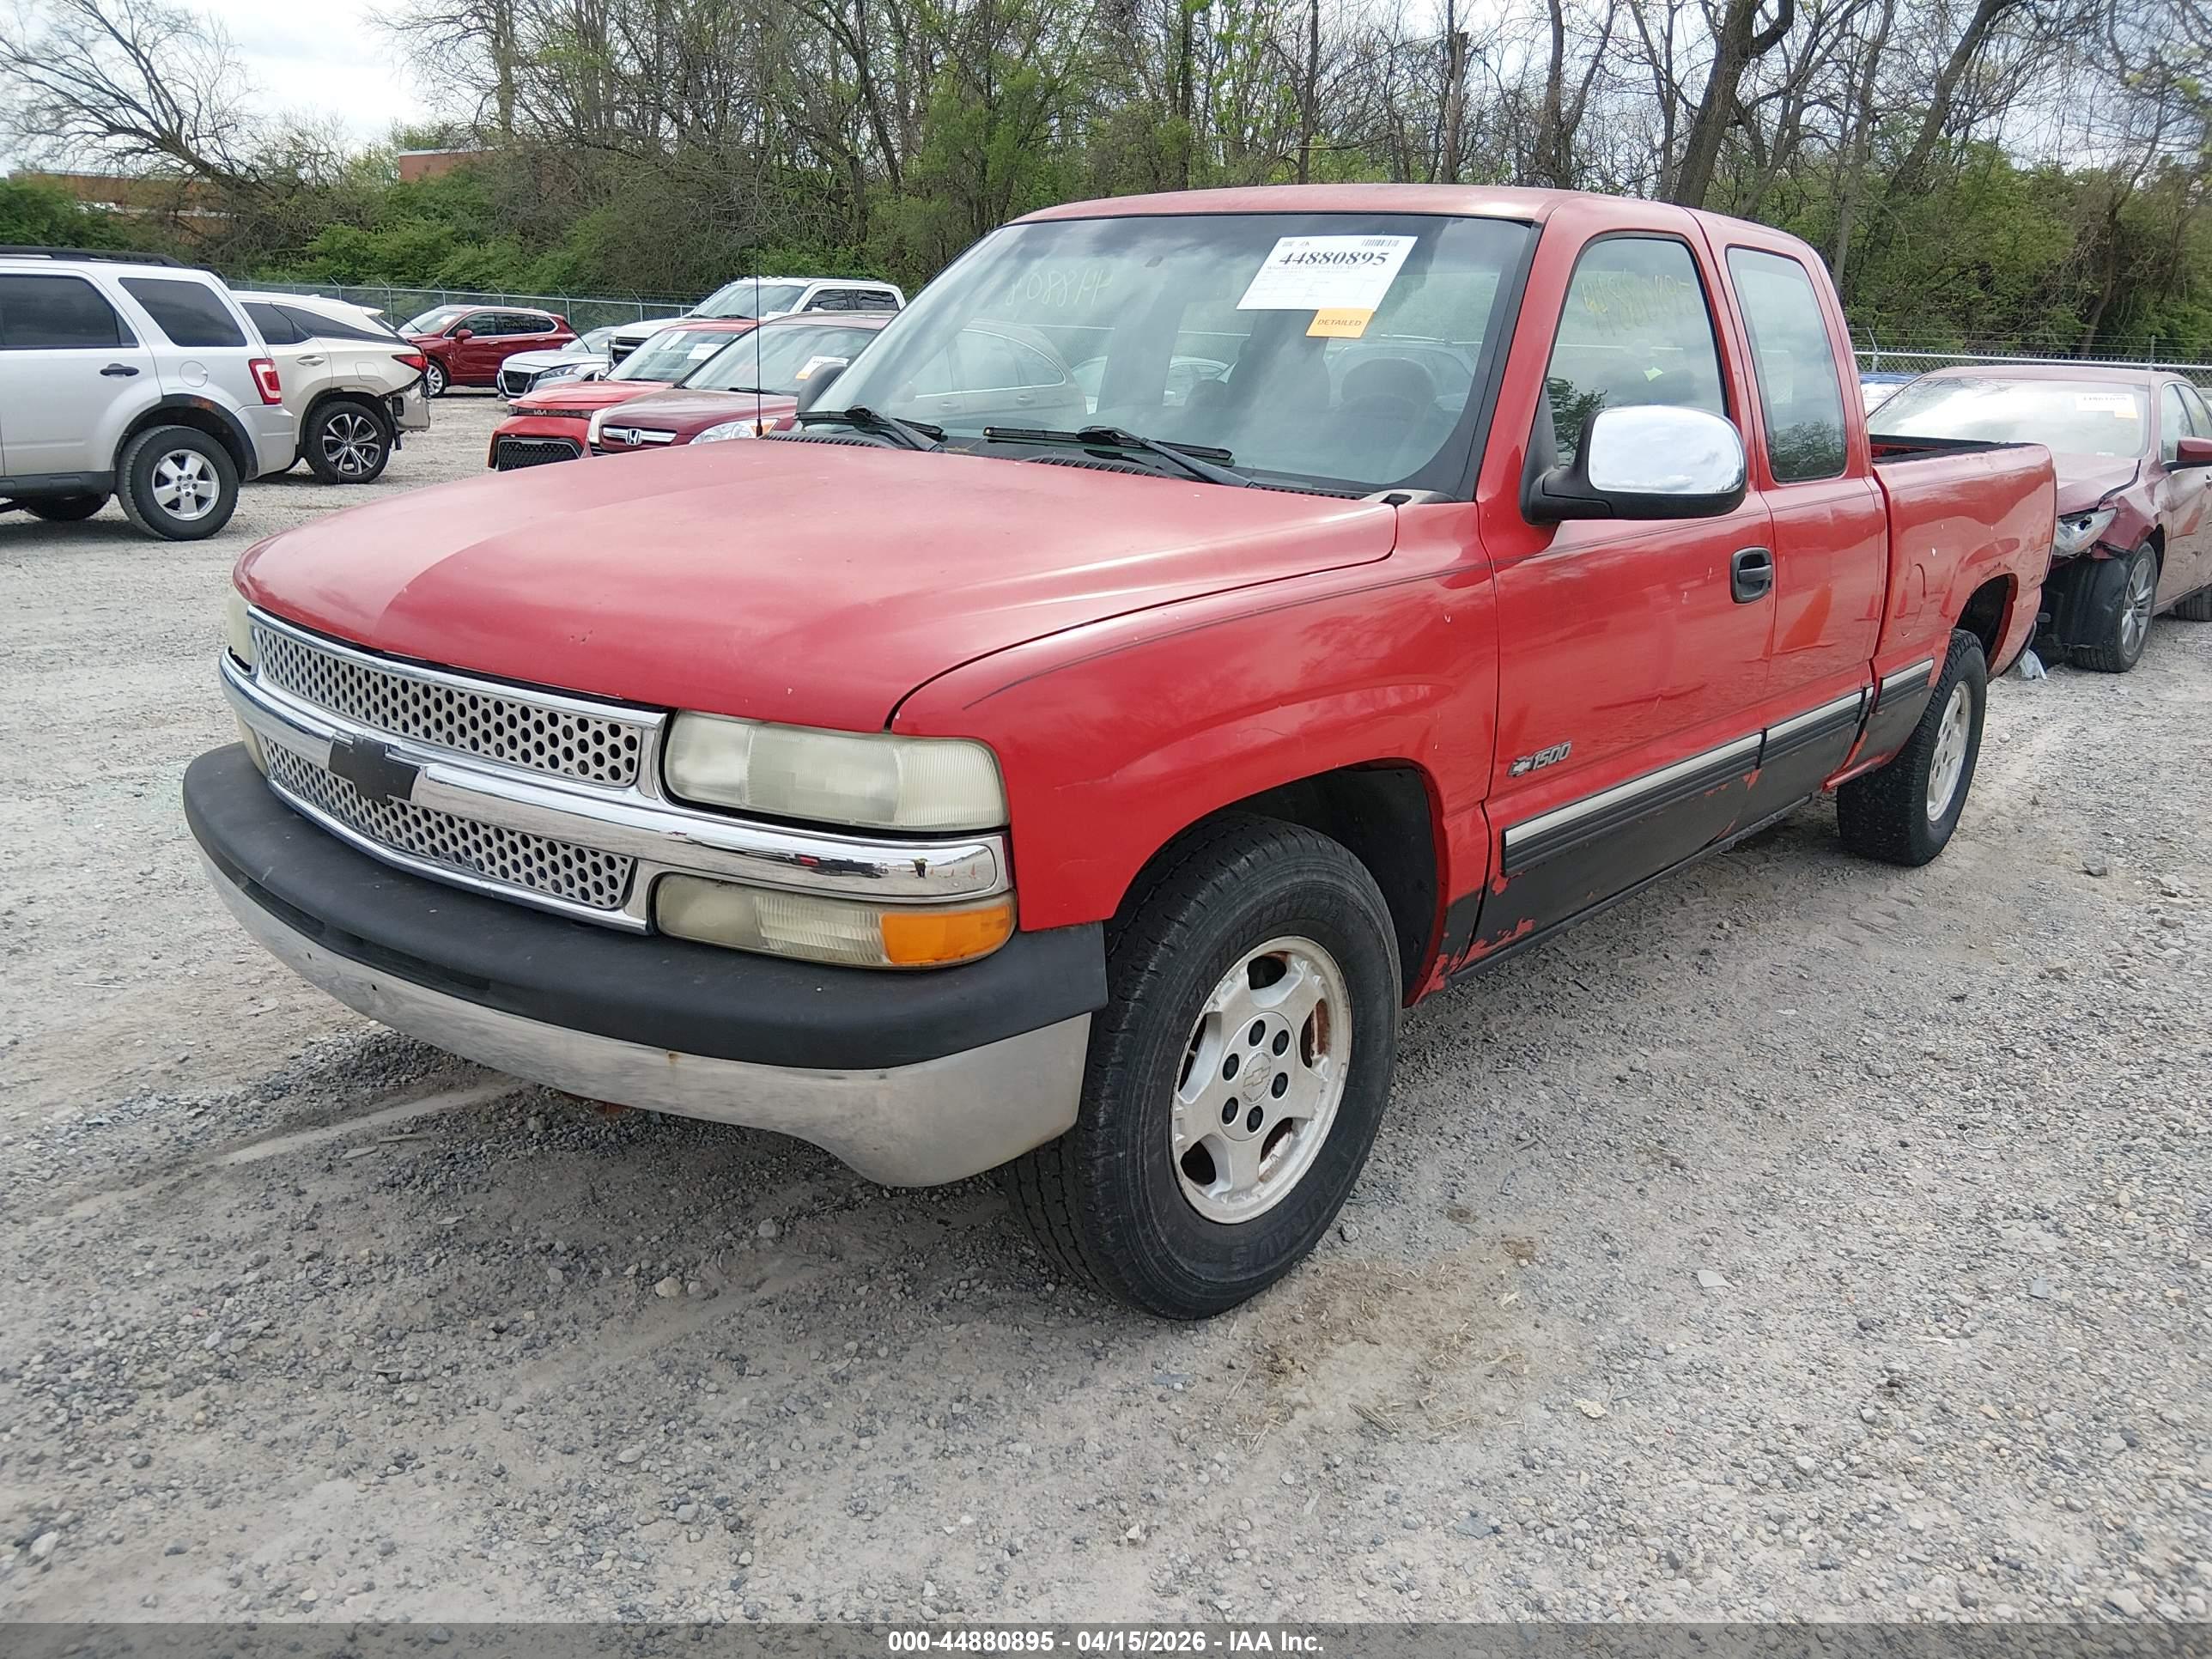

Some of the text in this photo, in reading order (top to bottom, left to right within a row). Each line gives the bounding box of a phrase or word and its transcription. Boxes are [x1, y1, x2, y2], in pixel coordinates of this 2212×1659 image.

[1279, 251, 1390, 266] 44880895
[1316, 318, 1363, 326] DETAILED
[1532, 740, 1572, 770] 1500
